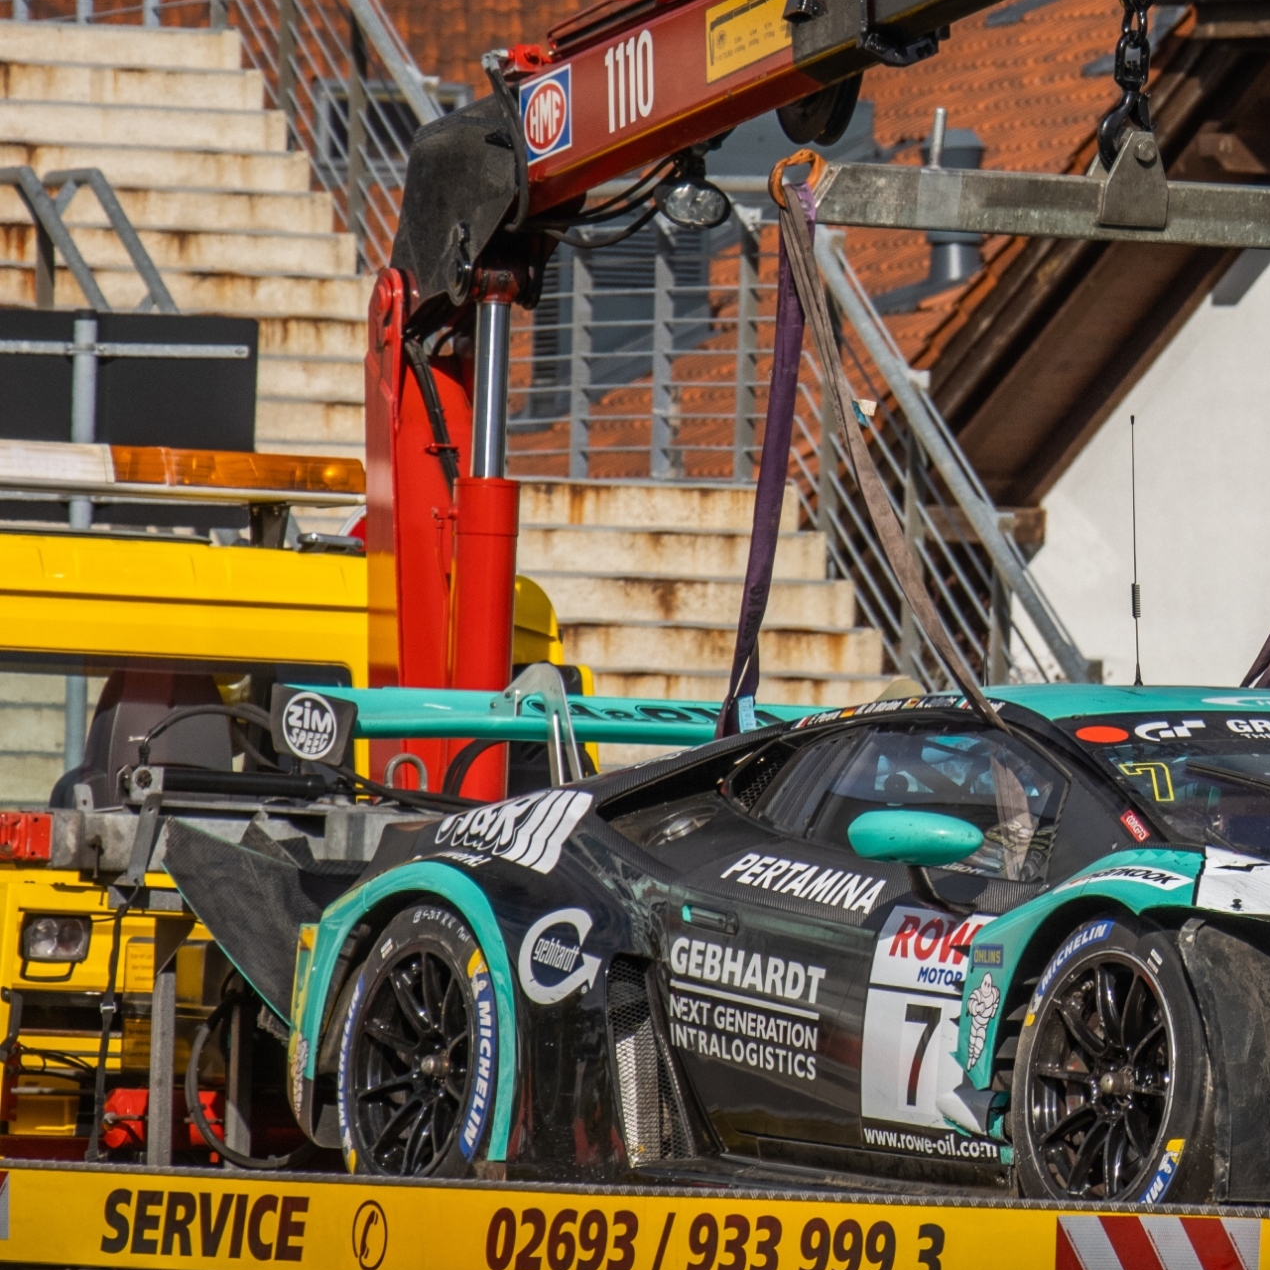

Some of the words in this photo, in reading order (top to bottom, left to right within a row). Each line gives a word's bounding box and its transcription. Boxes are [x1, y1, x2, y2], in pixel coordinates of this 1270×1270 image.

[605, 29, 655, 134] 1110
[527, 87, 563, 145] HMF
[1118, 761, 1175, 803] 7
[719, 852, 887, 915] PERTAMINA
[532, 937, 580, 973] gebhardt
[889, 913, 984, 966] ROW
[973, 946, 1002, 965] ÖHLINS
[1041, 922, 1109, 991] MICHELIN
[670, 936, 826, 1005] GEBHARDT
[669, 992, 711, 1026] NEXT
[713, 1004, 818, 1052] GENERATION
[669, 1022, 817, 1081] INTRALOGISTICS
[462, 999, 491, 1148] MICHELIN
[904, 1002, 942, 1107] 7
[863, 1127, 998, 1158] www.rowe-oil.com
[99, 1187, 310, 1263] SERVICE
